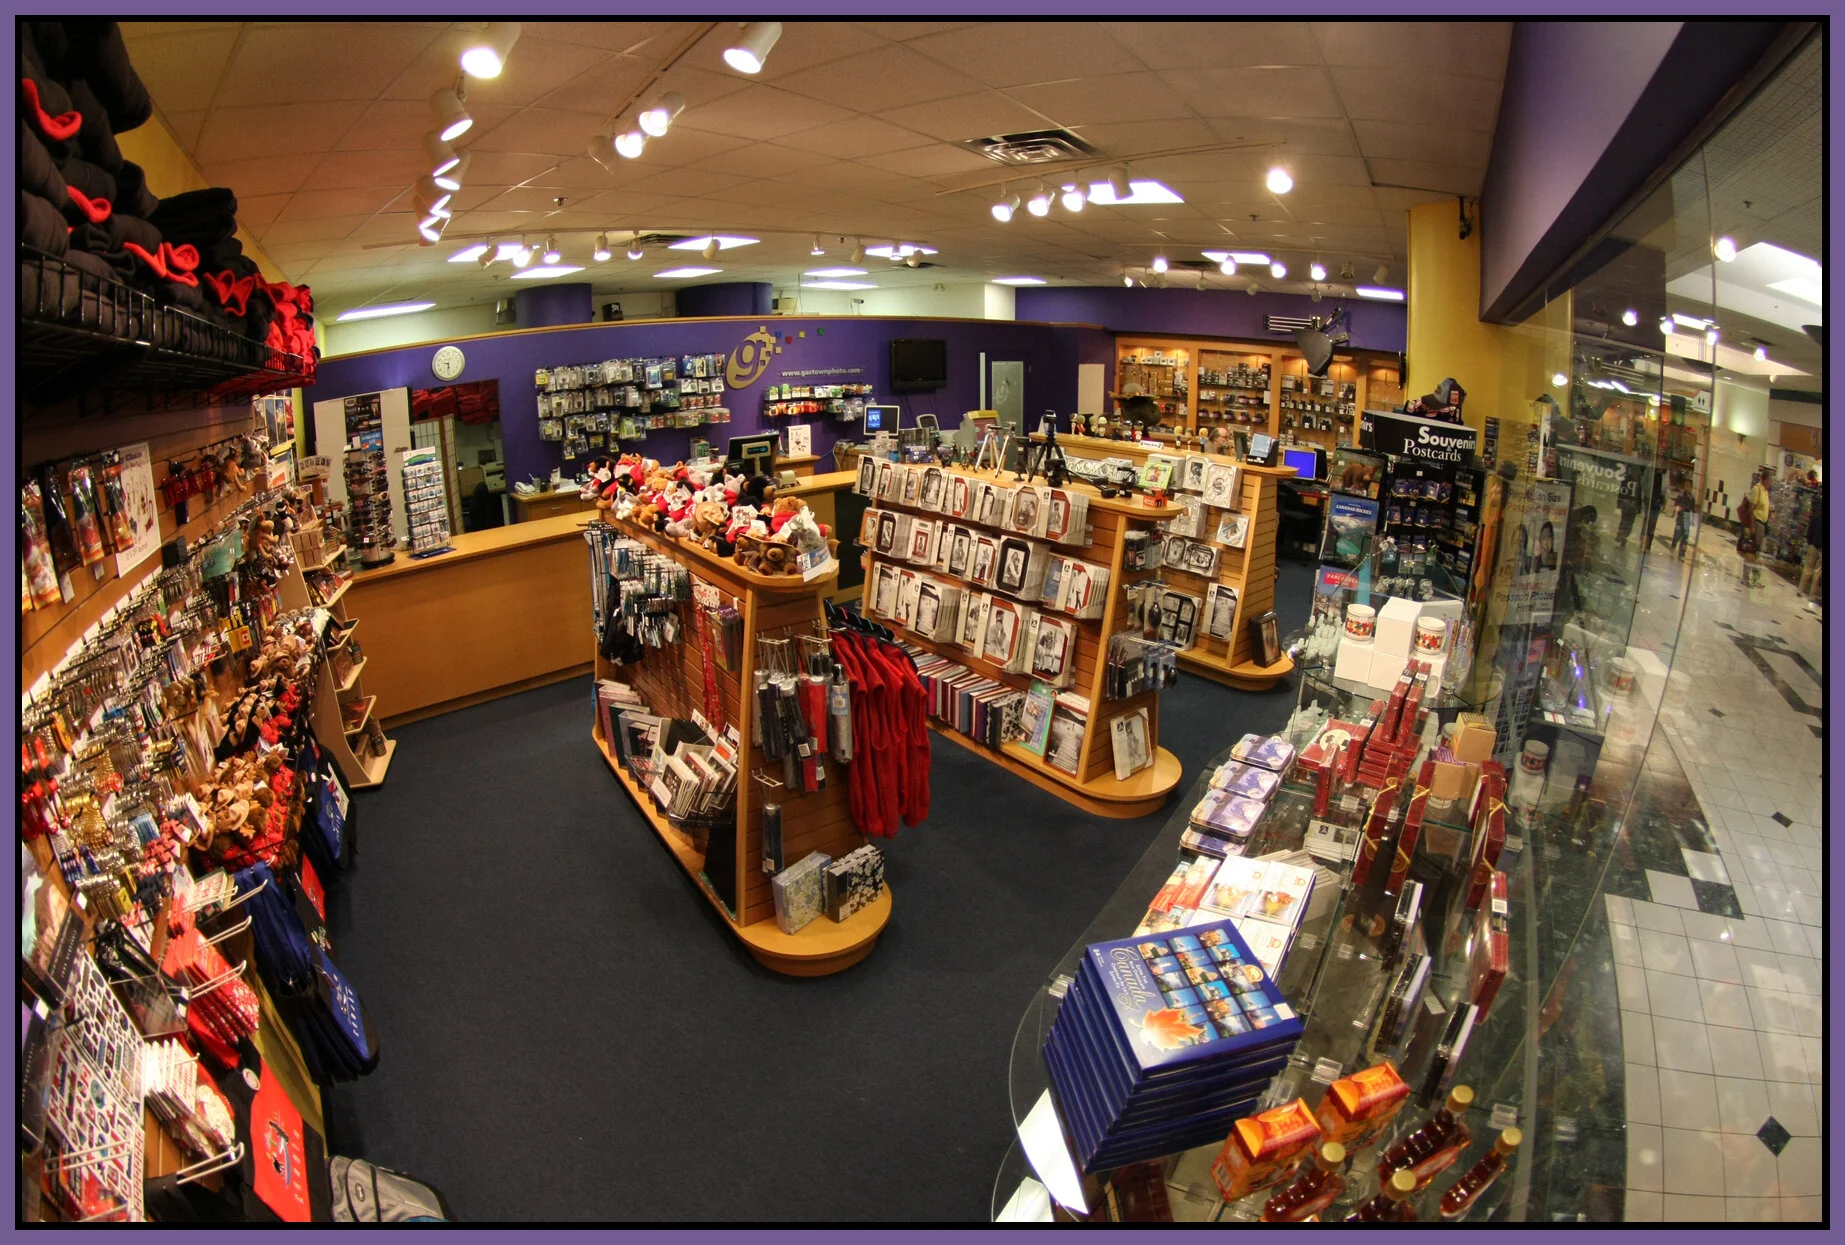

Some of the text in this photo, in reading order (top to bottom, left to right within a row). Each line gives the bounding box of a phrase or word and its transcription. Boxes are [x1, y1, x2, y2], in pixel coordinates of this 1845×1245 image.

[781, 367, 861, 377] www.gastownphoto.com
[1418, 426, 1476, 449] Souvenirs
[1402, 438, 1462, 461] Postcards
[1110, 946, 1157, 1008] Canada
